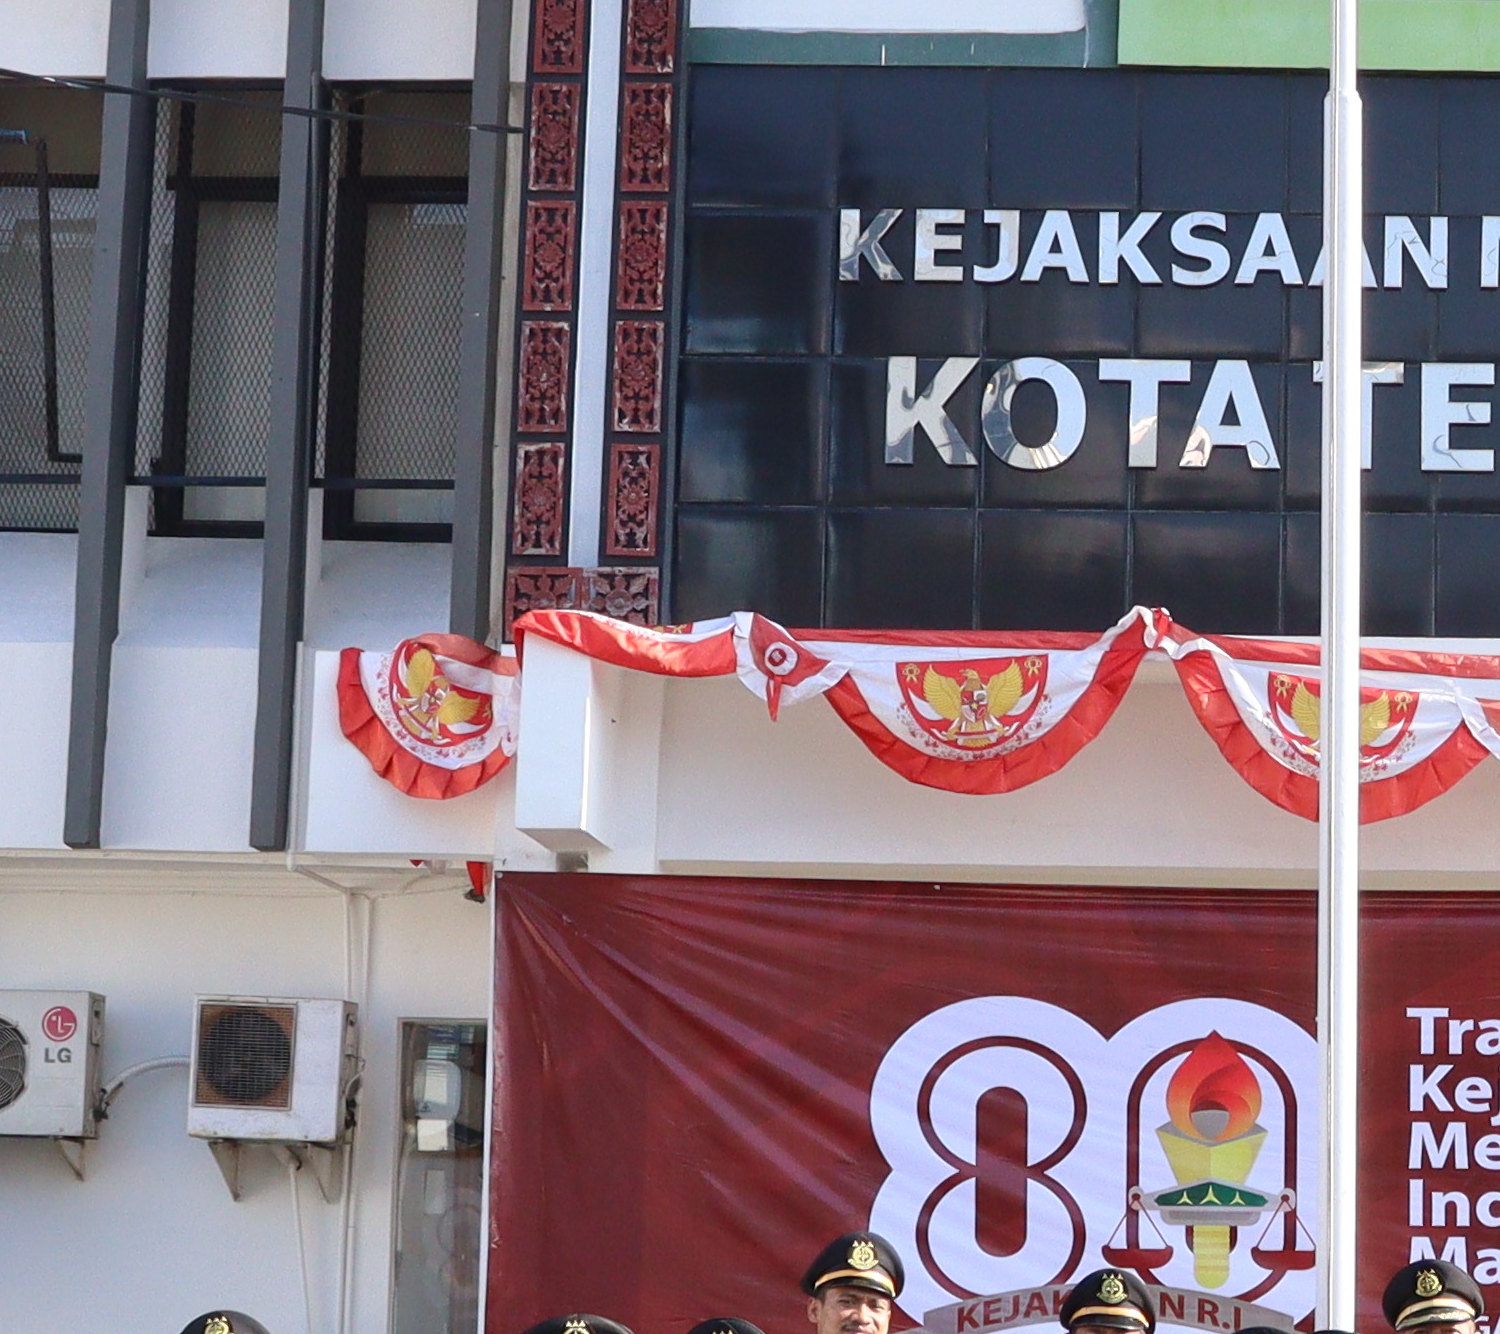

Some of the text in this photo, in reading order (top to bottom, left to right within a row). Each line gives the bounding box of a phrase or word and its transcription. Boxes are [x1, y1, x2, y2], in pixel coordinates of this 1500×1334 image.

[884, 356, 1281, 470] KOTA
[44, 1048, 73, 1064] LG
[956, 1289, 1185, 1334] KEJAKN
